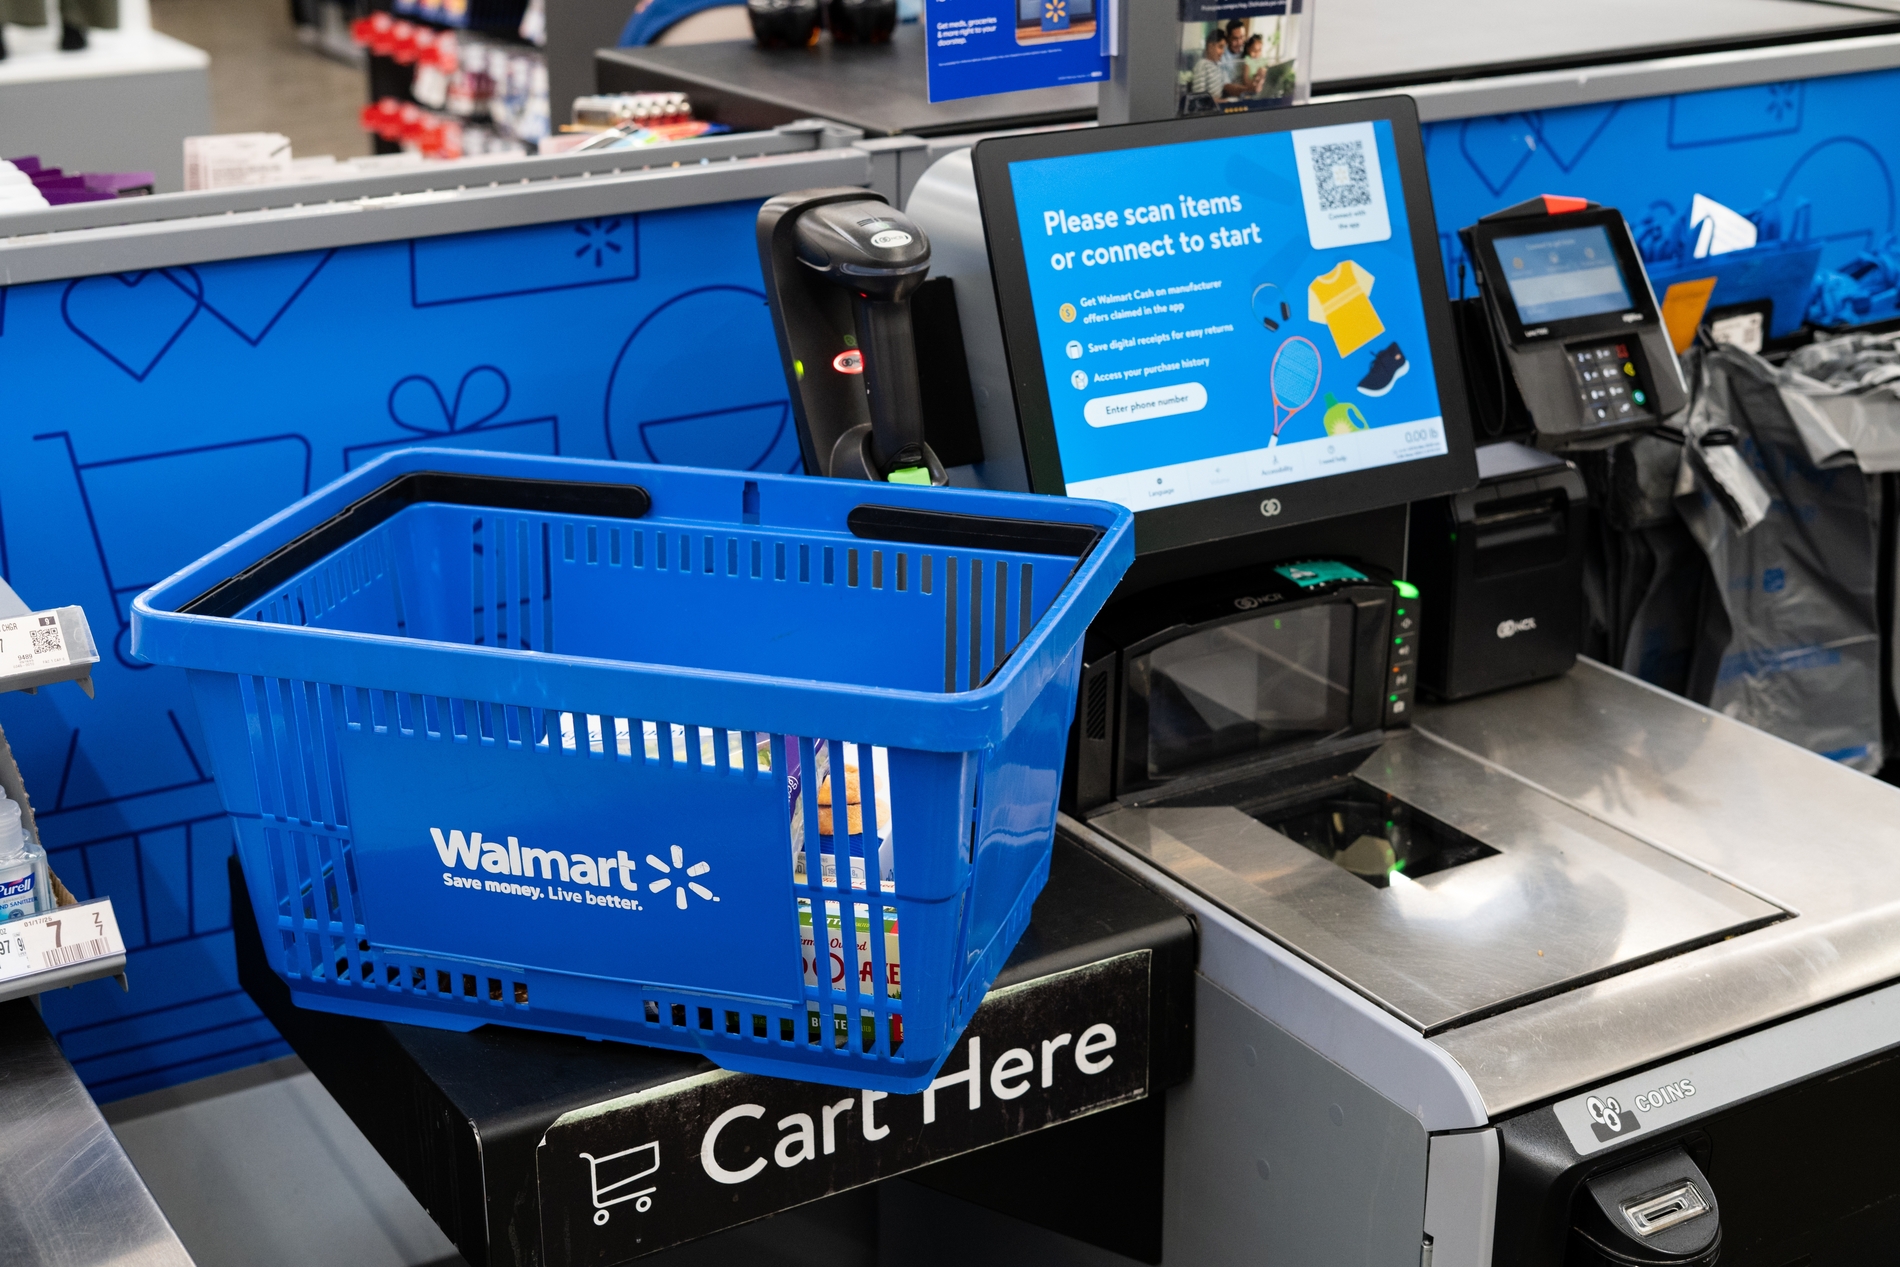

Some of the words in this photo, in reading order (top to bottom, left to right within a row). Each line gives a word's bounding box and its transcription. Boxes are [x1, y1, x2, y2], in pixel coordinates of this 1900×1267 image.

[937, 21, 949, 30] Get
[967, 17, 997, 27] groceries
[937, 31, 942, 39] &
[960, 27, 974, 36] right
[982, 26, 997, 34] your
[1043, 209, 1119, 236] Please
[1124, 203, 1175, 226] scan
[1179, 194, 1242, 219] items
[1050, 250, 1076, 271] or
[1081, 234, 1176, 267] connect
[1179, 232, 1205, 253] to
[1209, 222, 1263, 249] start
[1080, 297, 1097, 307] Get
[1097, 292, 1133, 305] Walmart
[1133, 288, 1155, 300] Cash
[1155, 288, 1167, 297] on
[1167, 280, 1223, 295] manufacturer
[1083, 313, 1109, 324] offers
[1110, 306, 1143, 320] claimed
[1143, 305, 1153, 315] in
[1152, 303, 1168, 314] the
[1169, 302, 1185, 313] app
[1087, 343, 1108, 353] Save
[1109, 337, 1136, 351] digital
[1137, 333, 1171, 345] receipts
[1171, 330, 1184, 340] for
[1185, 328, 1203, 338] easy
[1204, 324, 1234, 335] returns
[1094, 372, 1122, 383] Access
[1123, 368, 1142, 380] your
[1143, 362, 1181, 377] purchase
[1181, 357, 1210, 370] history
[1105, 405, 1128, 415] Enter
[1131, 402, 1156, 413] phone
[1157, 395, 1189, 406] number
[1405, 429, 1428, 443] 0.00
[1261, 466, 1293, 476] Accessibility
[1148, 488, 1175, 498] Language
[1257, 593, 1284, 605] NCR
[430, 827, 638, 891] Walmart
[442, 872, 482, 890] Save
[484, 879, 545, 900] money.
[548, 886, 582, 903] Live
[585, 891, 643, 911] better.
[24, 916, 53, 928] 01/17/25
[92, 912, 102, 924] Z
[46, 920, 62, 948] 7
[95, 924, 104, 936] 7
[700, 1091, 890, 1185] Cart
[923, 1022, 1118, 1126] Here
[1634, 1079, 1696, 1112] COINS
